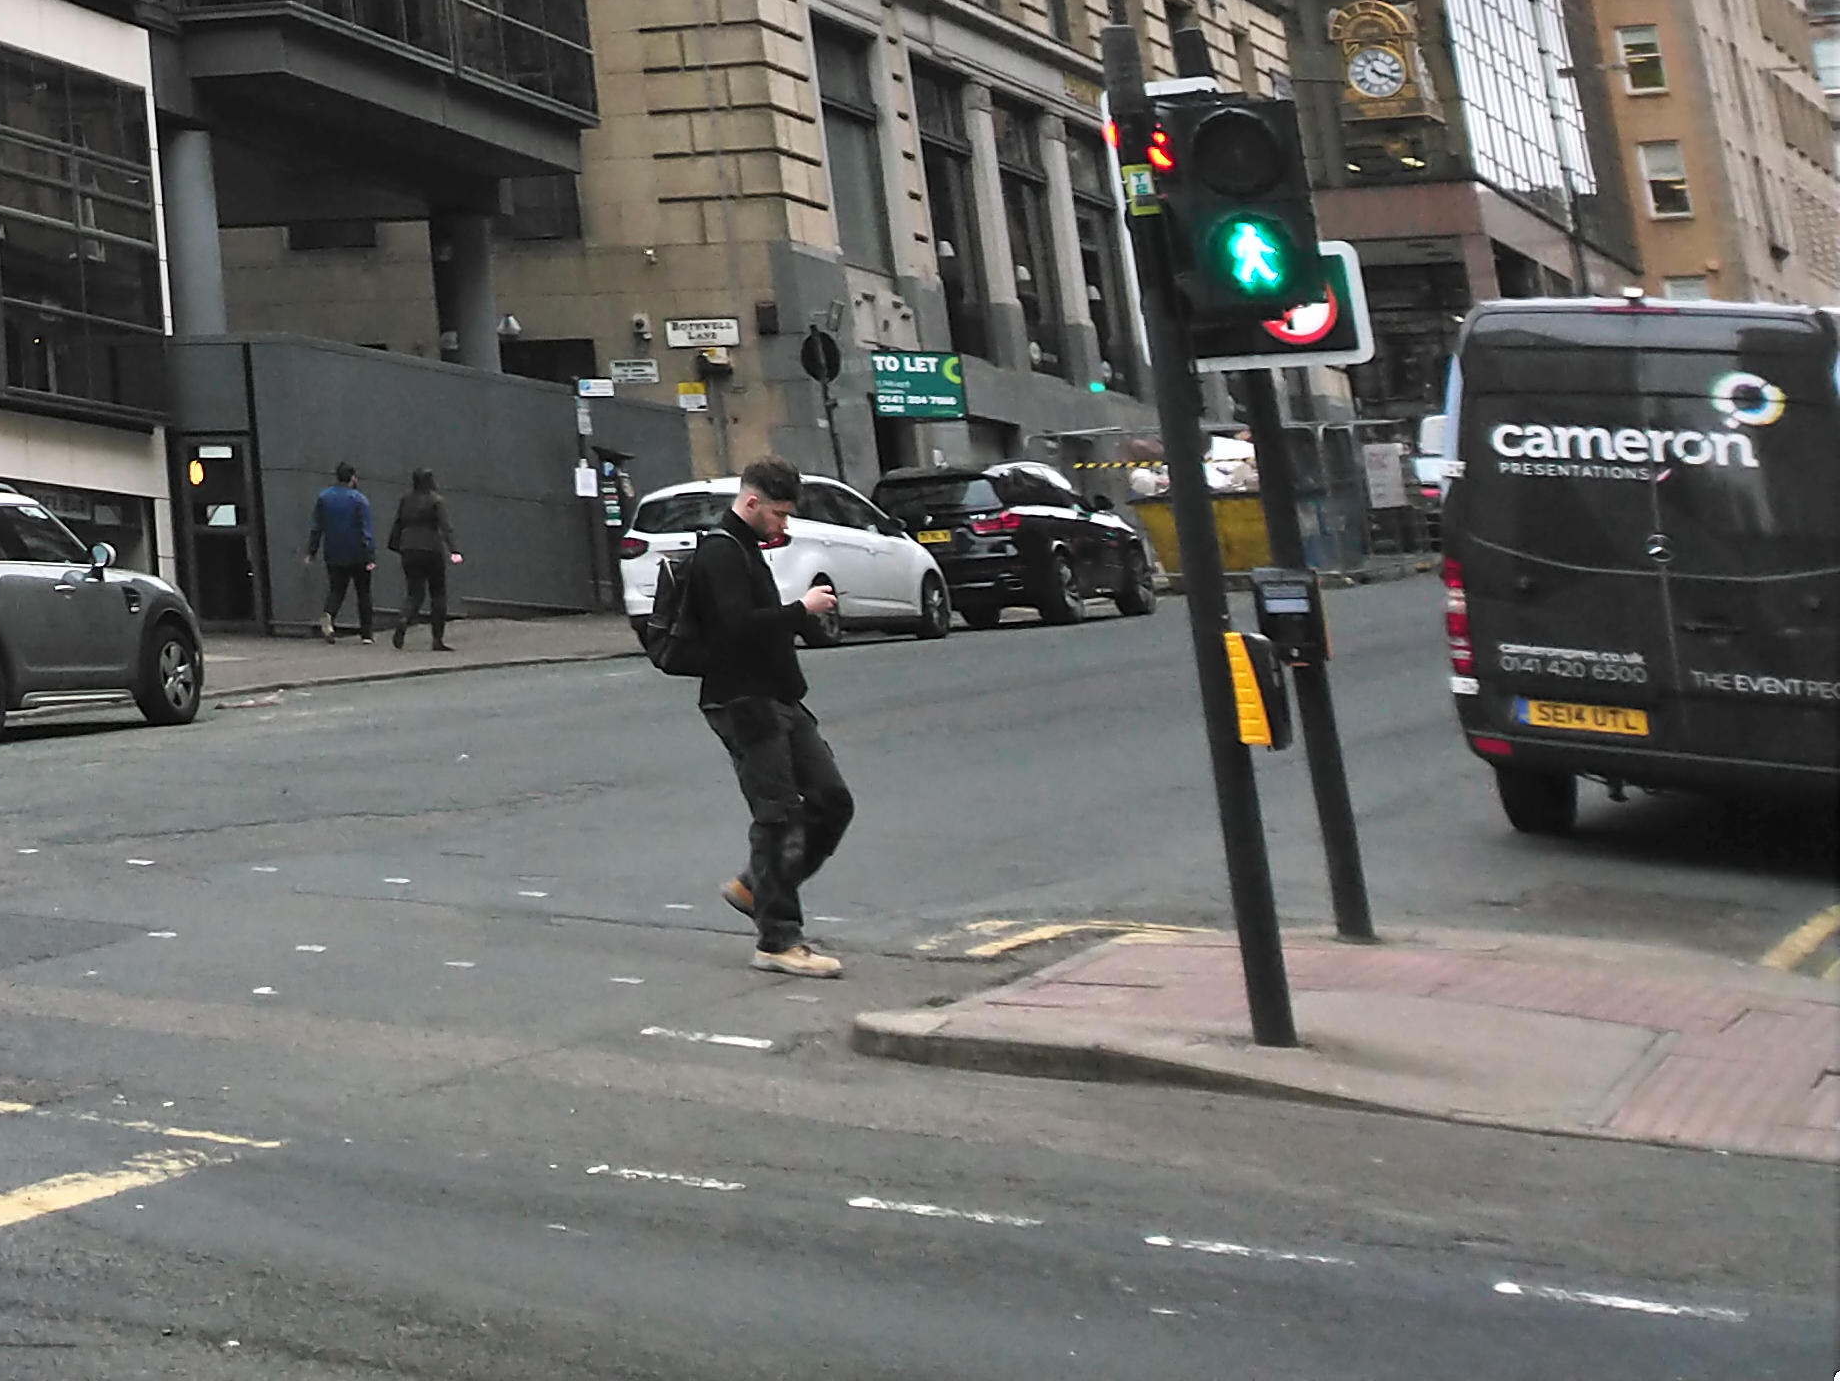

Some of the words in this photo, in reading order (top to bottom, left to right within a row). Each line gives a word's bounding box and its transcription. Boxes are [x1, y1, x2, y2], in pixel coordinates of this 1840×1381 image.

[872, 355, 900, 372] TO
[904, 356, 938, 373] LET
[1491, 424, 1760, 468] cameron
[1499, 462, 1651, 481] PRESENTATIONS
[1499, 655, 1542, 675] 0141
[1546, 660, 1586, 679] 420
[1591, 665, 1648, 684] 6500
[1690, 670, 1732, 690] THE
[1734, 674, 1802, 695] EVENT
[1537, 703, 1585, 723] SE14
[1593, 709, 1639, 730] UTL
